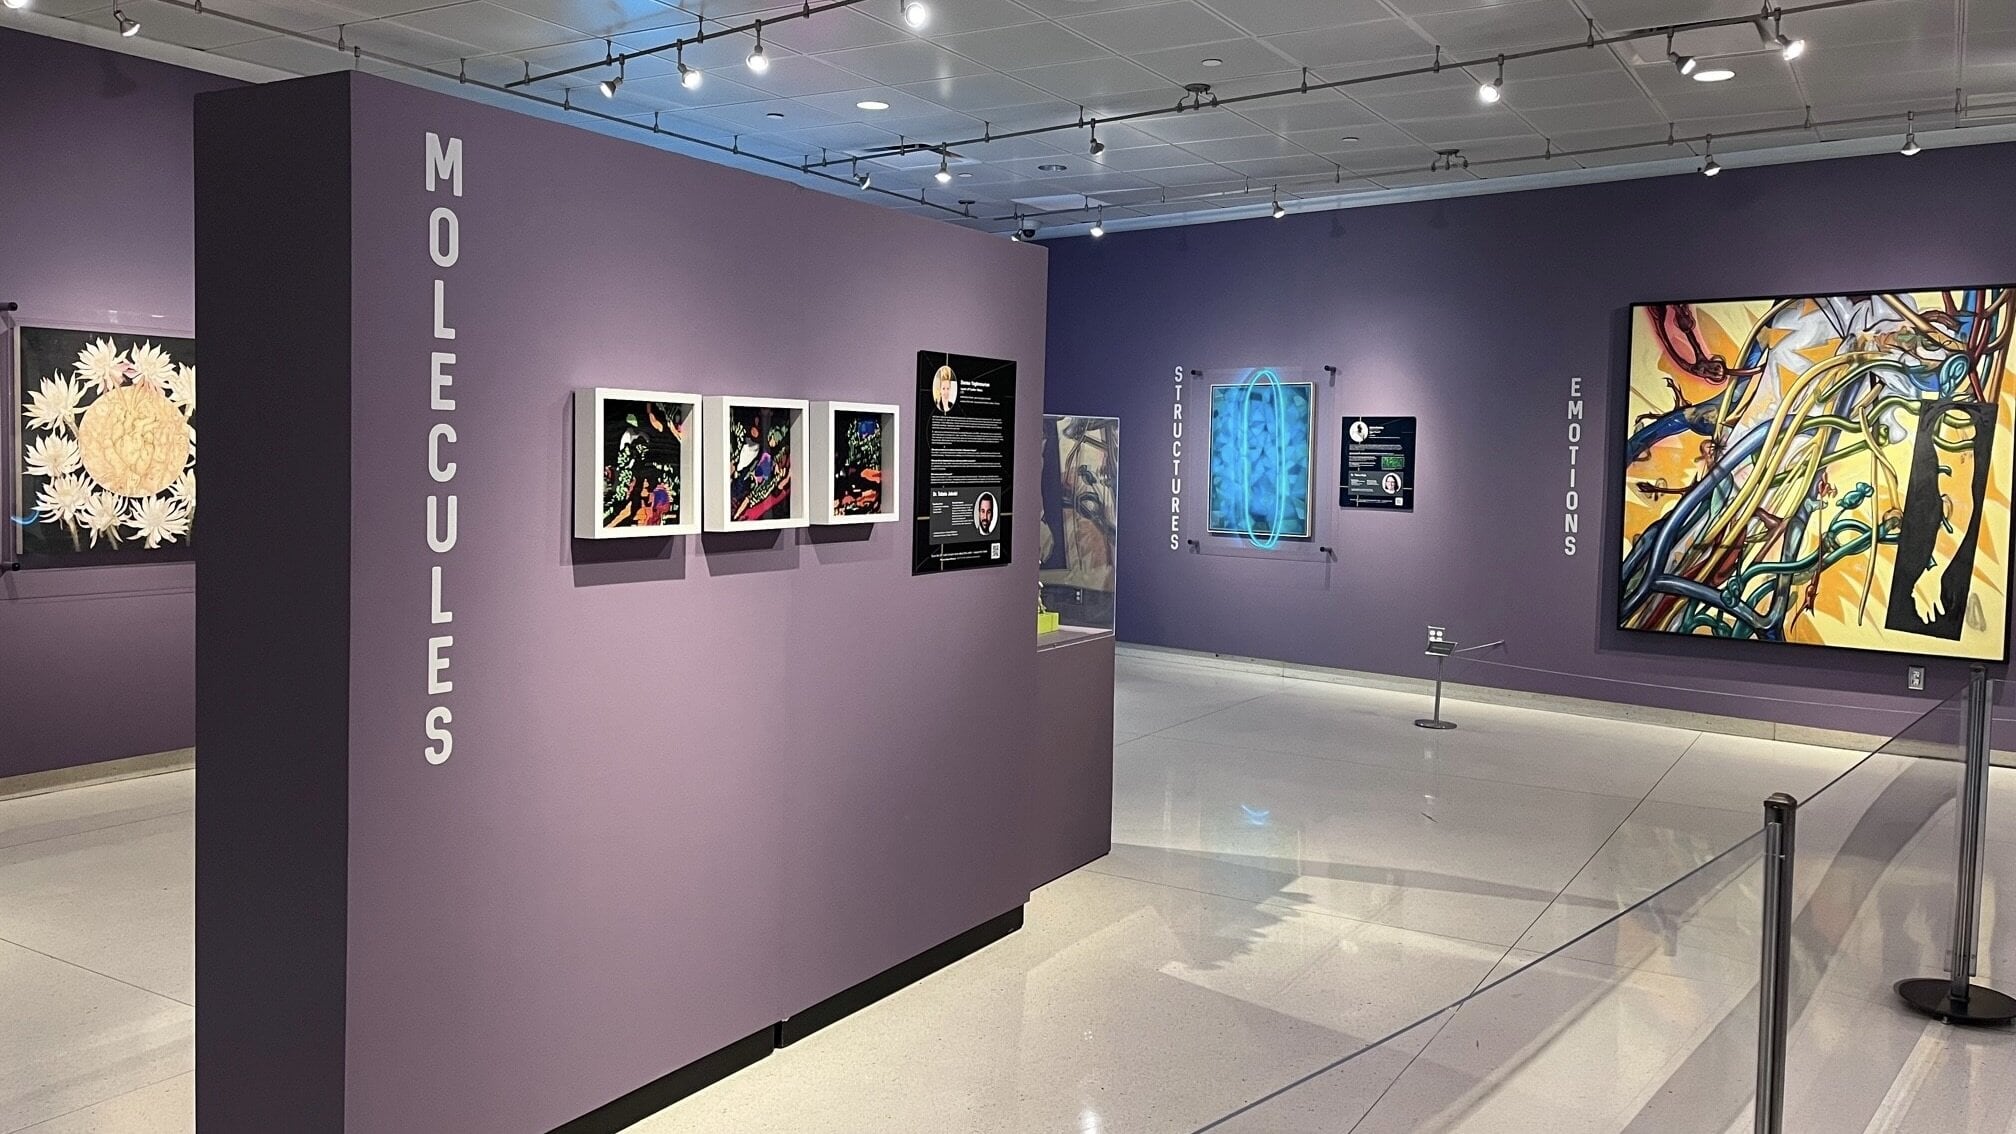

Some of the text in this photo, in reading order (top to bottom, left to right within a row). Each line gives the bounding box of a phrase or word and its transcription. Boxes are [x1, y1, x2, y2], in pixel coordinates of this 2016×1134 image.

[424, 131, 463, 765] MOLECULES
[1170, 366, 1183, 550] STRUCTURES
[1564, 377, 1584, 556] EMOTIONS
